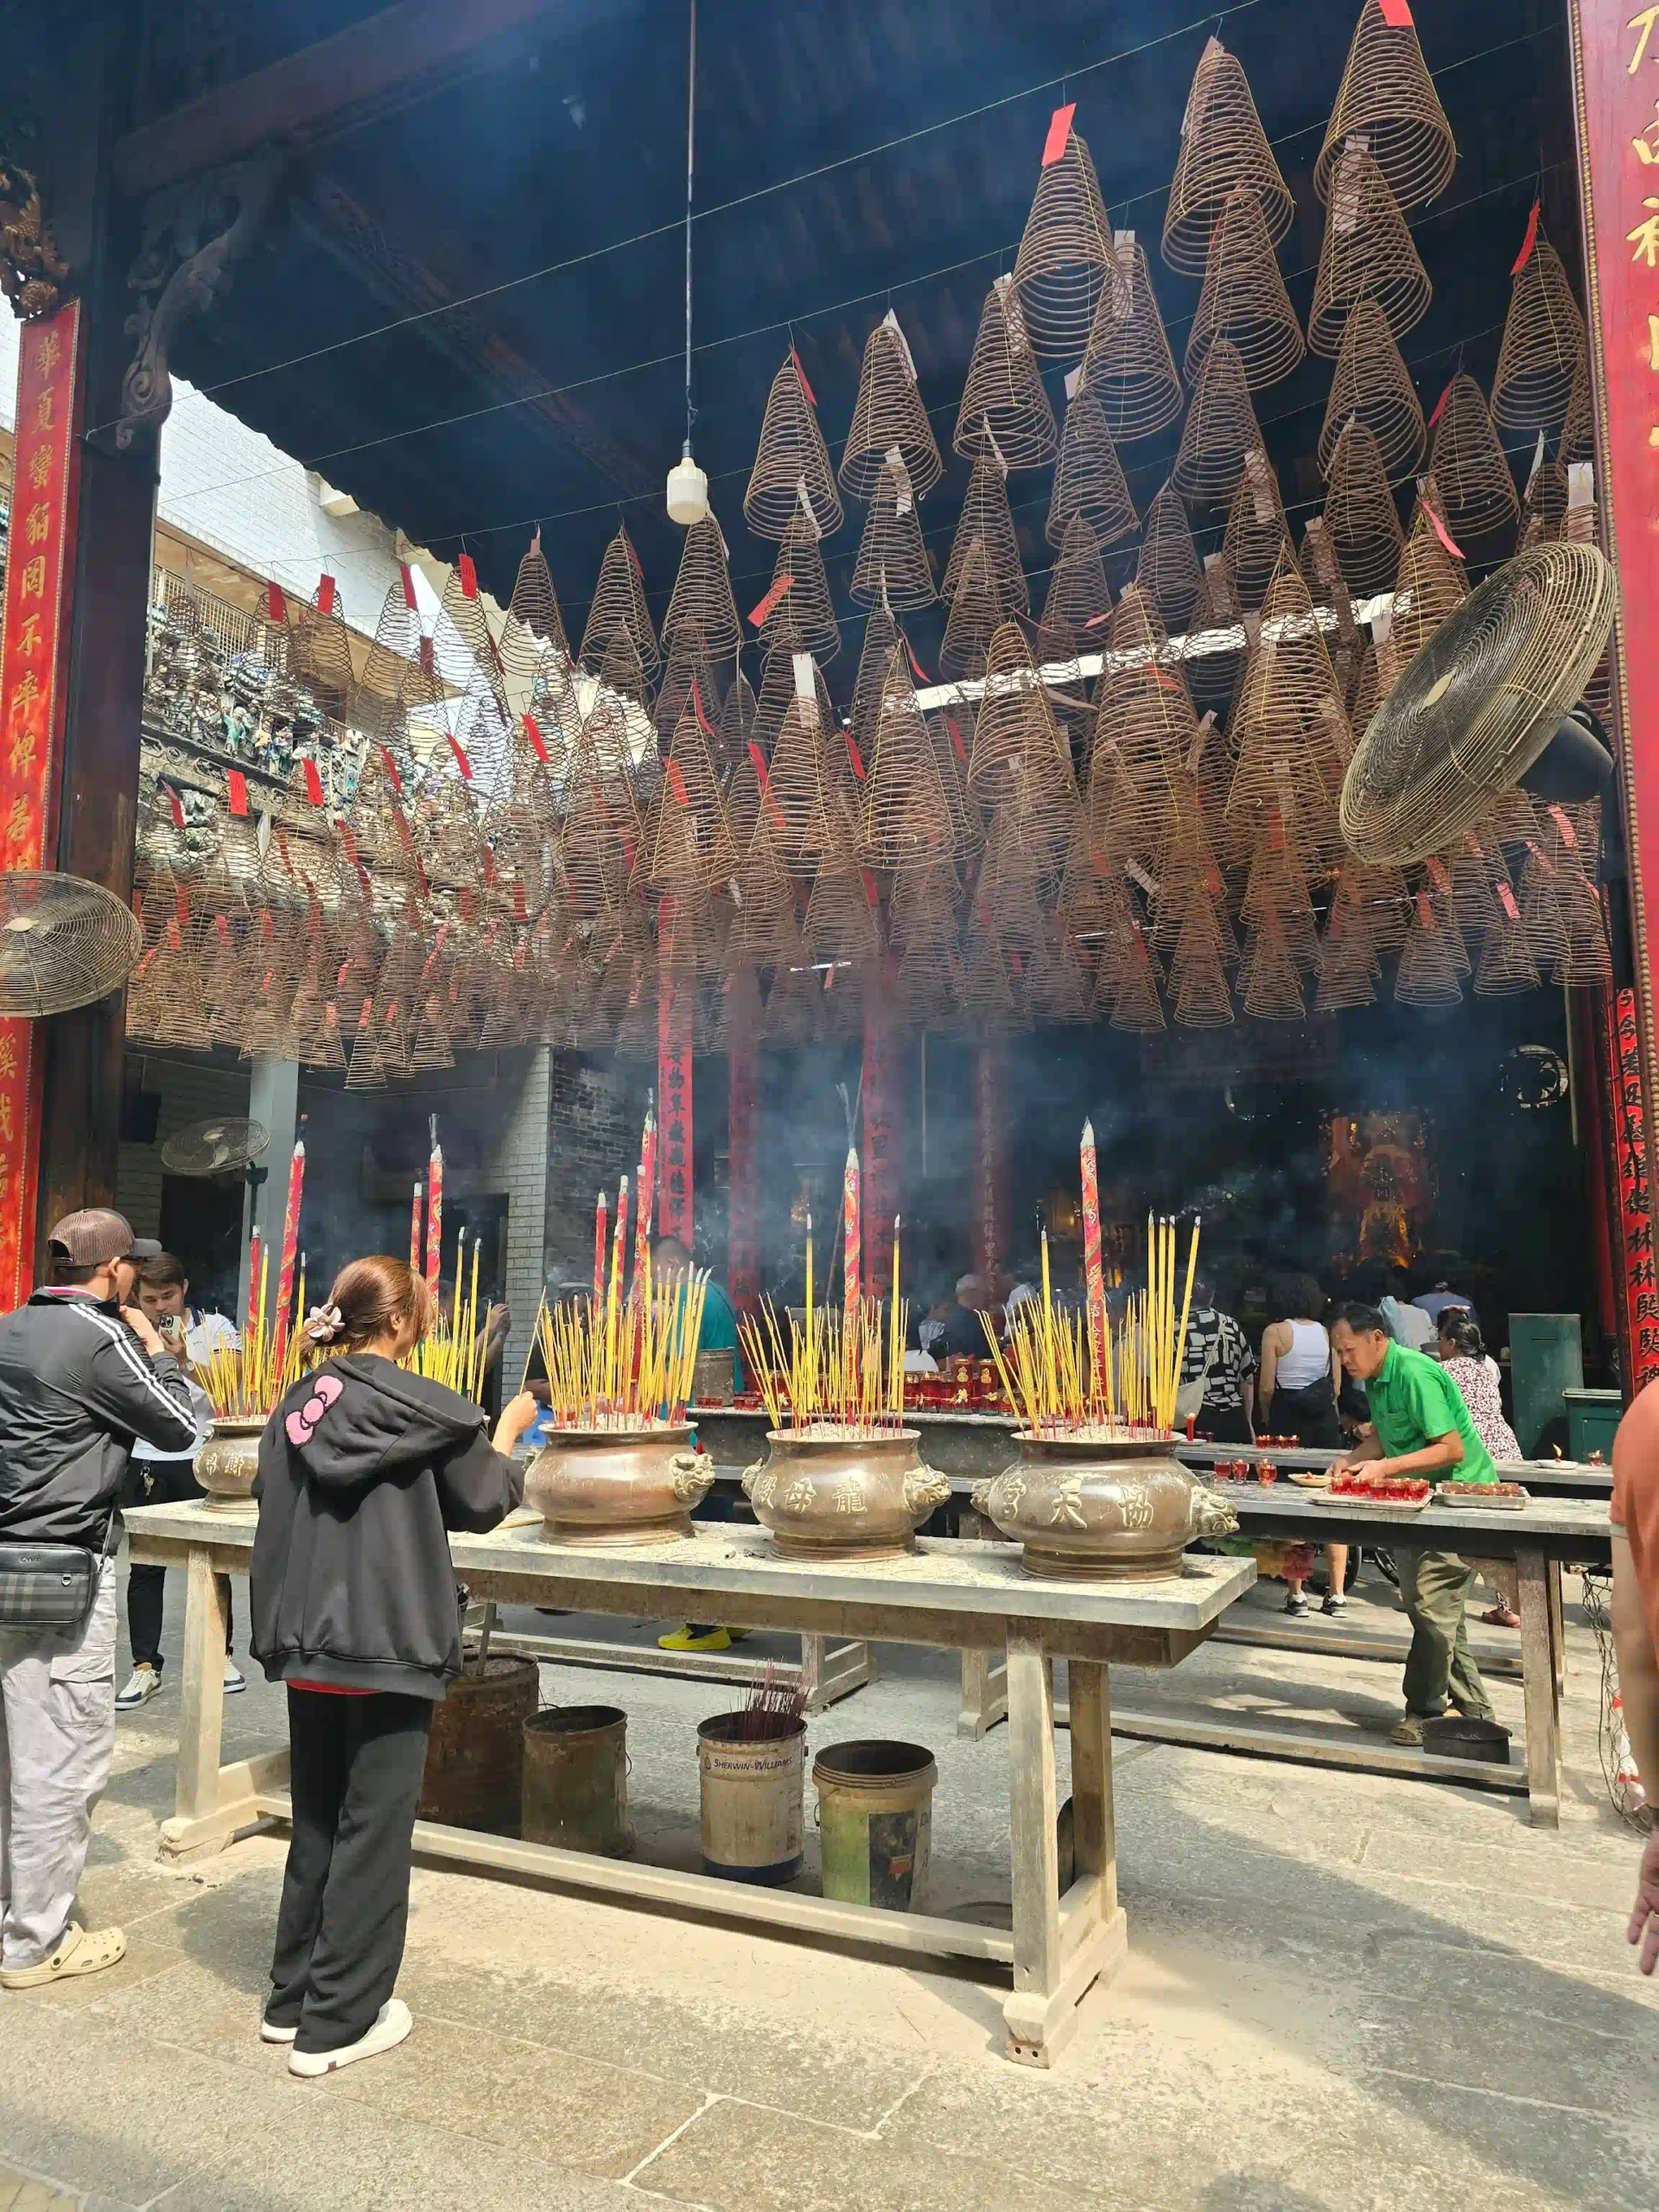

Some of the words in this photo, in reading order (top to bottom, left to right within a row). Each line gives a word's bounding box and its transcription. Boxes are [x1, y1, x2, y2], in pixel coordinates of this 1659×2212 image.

[6, 329, 61, 872] 華夏蠻貊罔不率俾若
